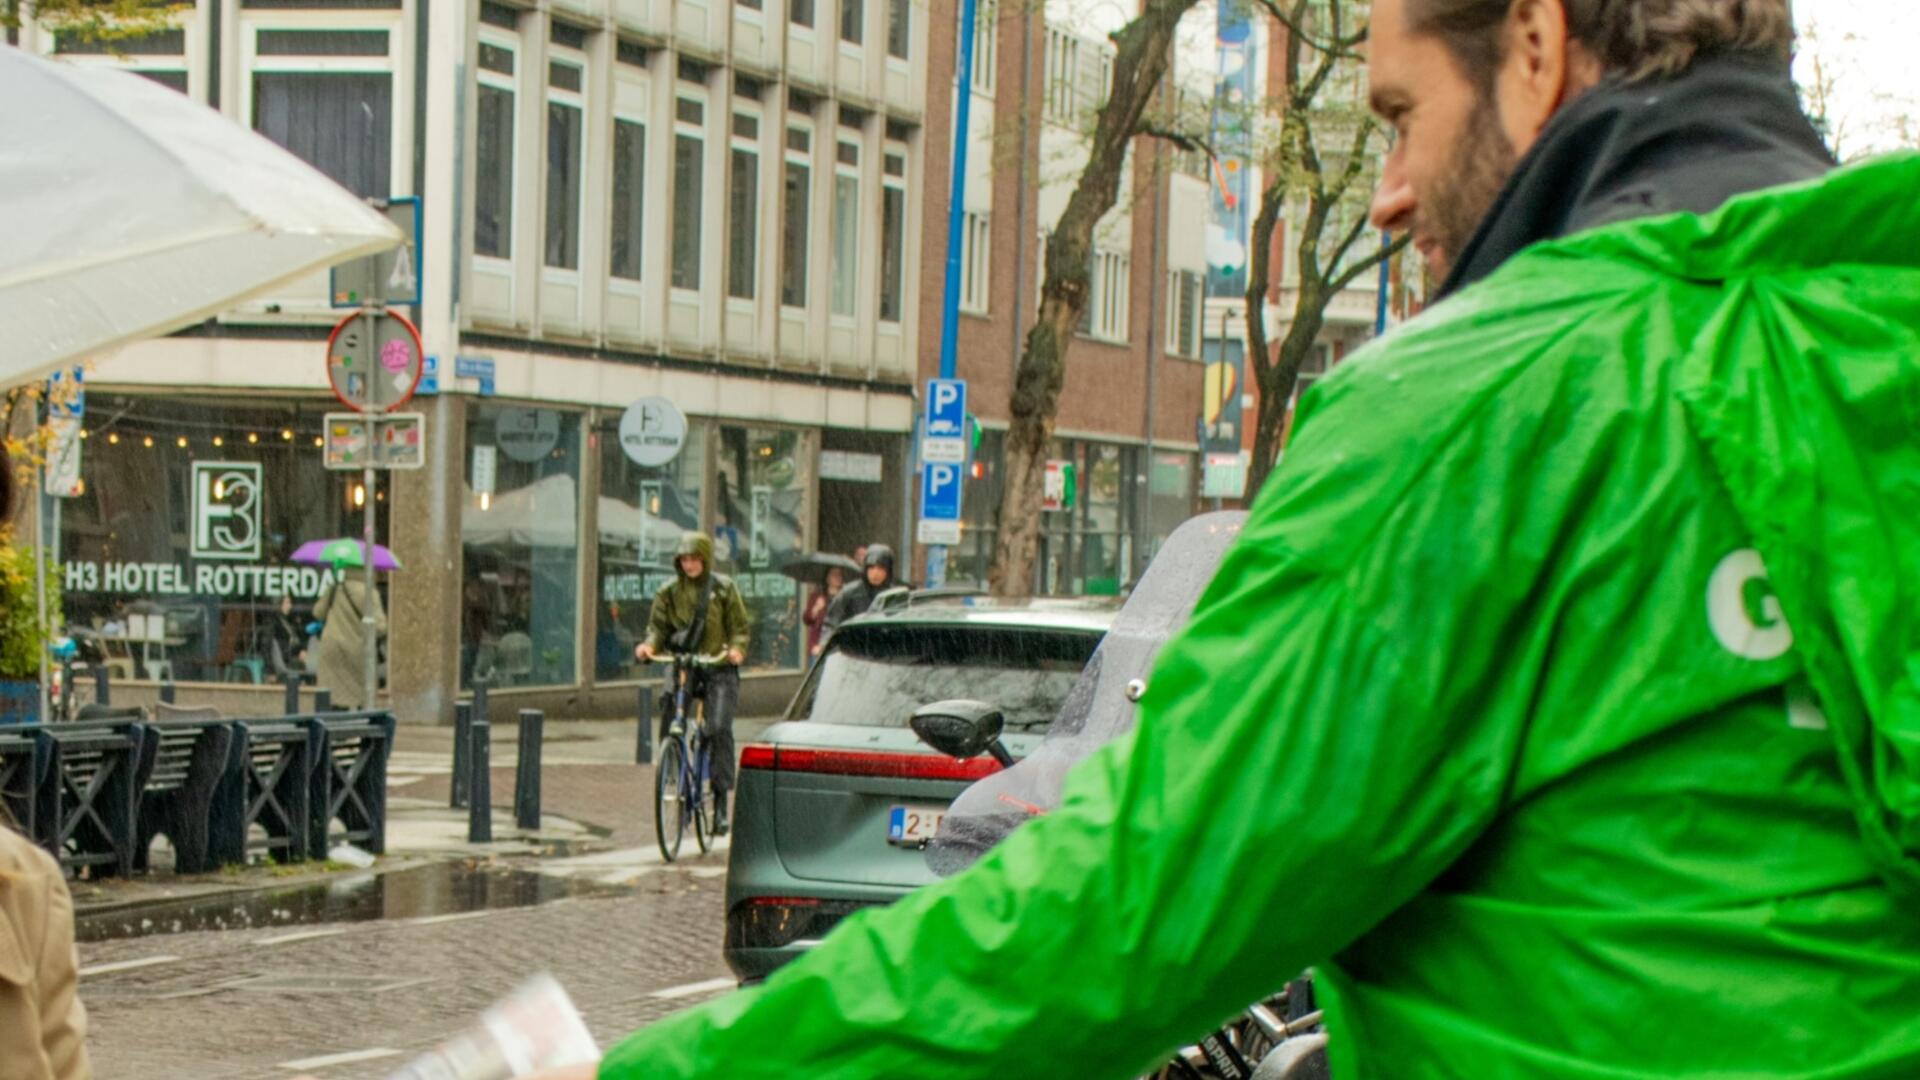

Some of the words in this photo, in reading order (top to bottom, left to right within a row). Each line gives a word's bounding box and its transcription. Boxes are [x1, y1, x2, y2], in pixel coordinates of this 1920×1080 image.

[934, 383, 958, 416] P
[931, 465, 954, 496] P
[65, 561, 98, 591] H3
[104, 562, 191, 594] HOTEL
[195, 564, 346, 598] ROTTERDA
[1706, 548, 1794, 660] G
[1202, 1033, 1242, 1080] SPRIT
